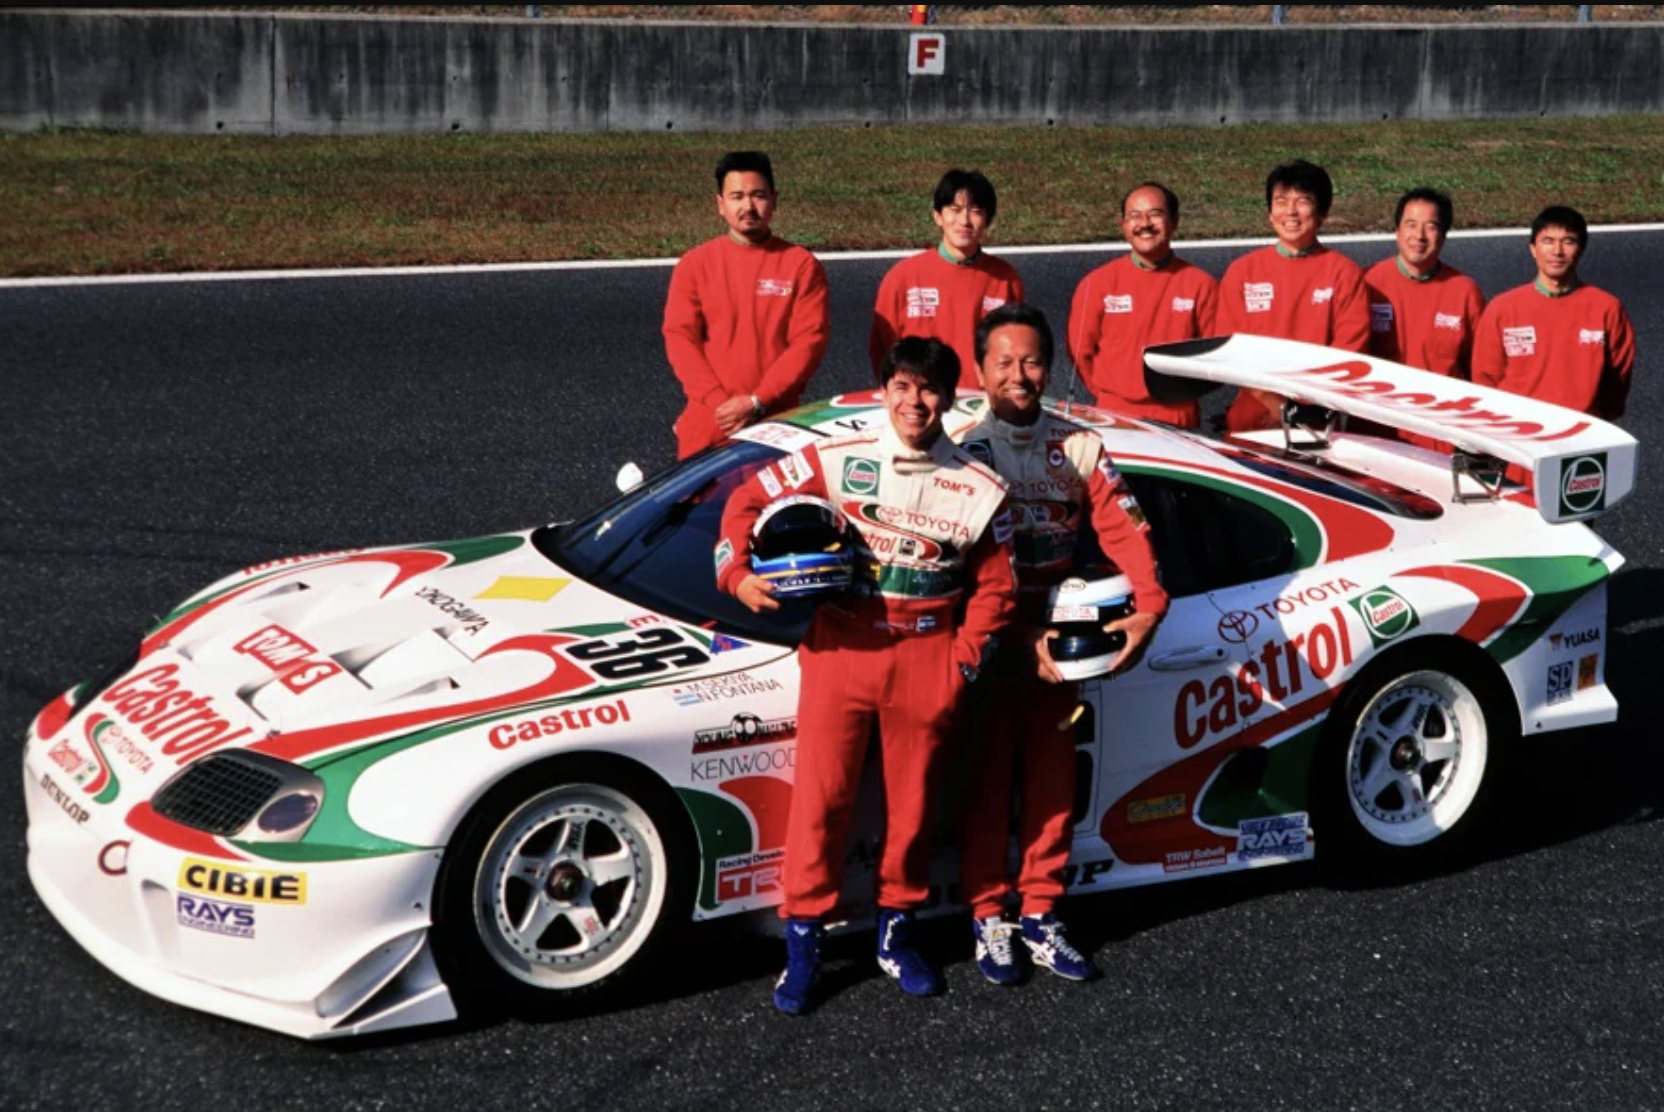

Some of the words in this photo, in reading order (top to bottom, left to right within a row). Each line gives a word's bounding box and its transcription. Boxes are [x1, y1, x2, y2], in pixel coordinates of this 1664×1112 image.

[917, 38, 939, 68] F
[906, 511, 971, 539] TOYOTA
[1255, 577, 1360, 620] TOYOTA
[1372, 598, 1405, 624] Castrol
[565, 628, 711, 680] 36
[1564, 627, 1600, 649] YUASA
[1174, 606, 1354, 750] Castrol
[102, 663, 254, 766] Castrol
[488, 699, 631, 750] Castrol
[40, 773, 91, 825] DUNLOP
[1241, 828, 1306, 850] RAYS
[186, 865, 299, 900] CIBIE
[178, 896, 254, 927] RAYS
